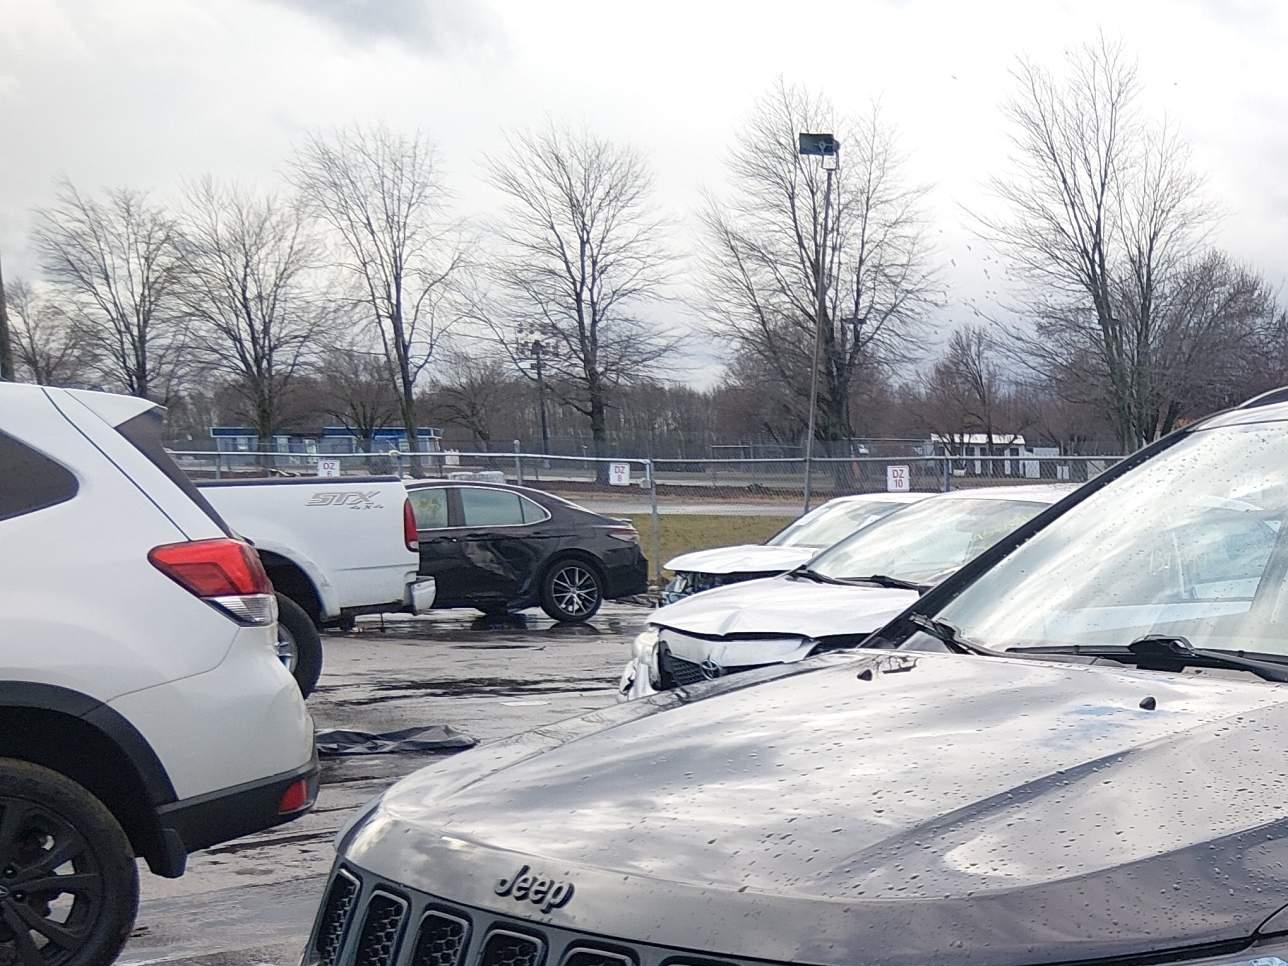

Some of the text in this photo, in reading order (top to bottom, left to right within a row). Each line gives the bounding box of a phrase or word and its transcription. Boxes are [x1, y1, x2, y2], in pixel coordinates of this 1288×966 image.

[892, 469, 905, 479] DZ
[894, 479, 904, 489] 10
[494, 864, 575, 914] Jeep
